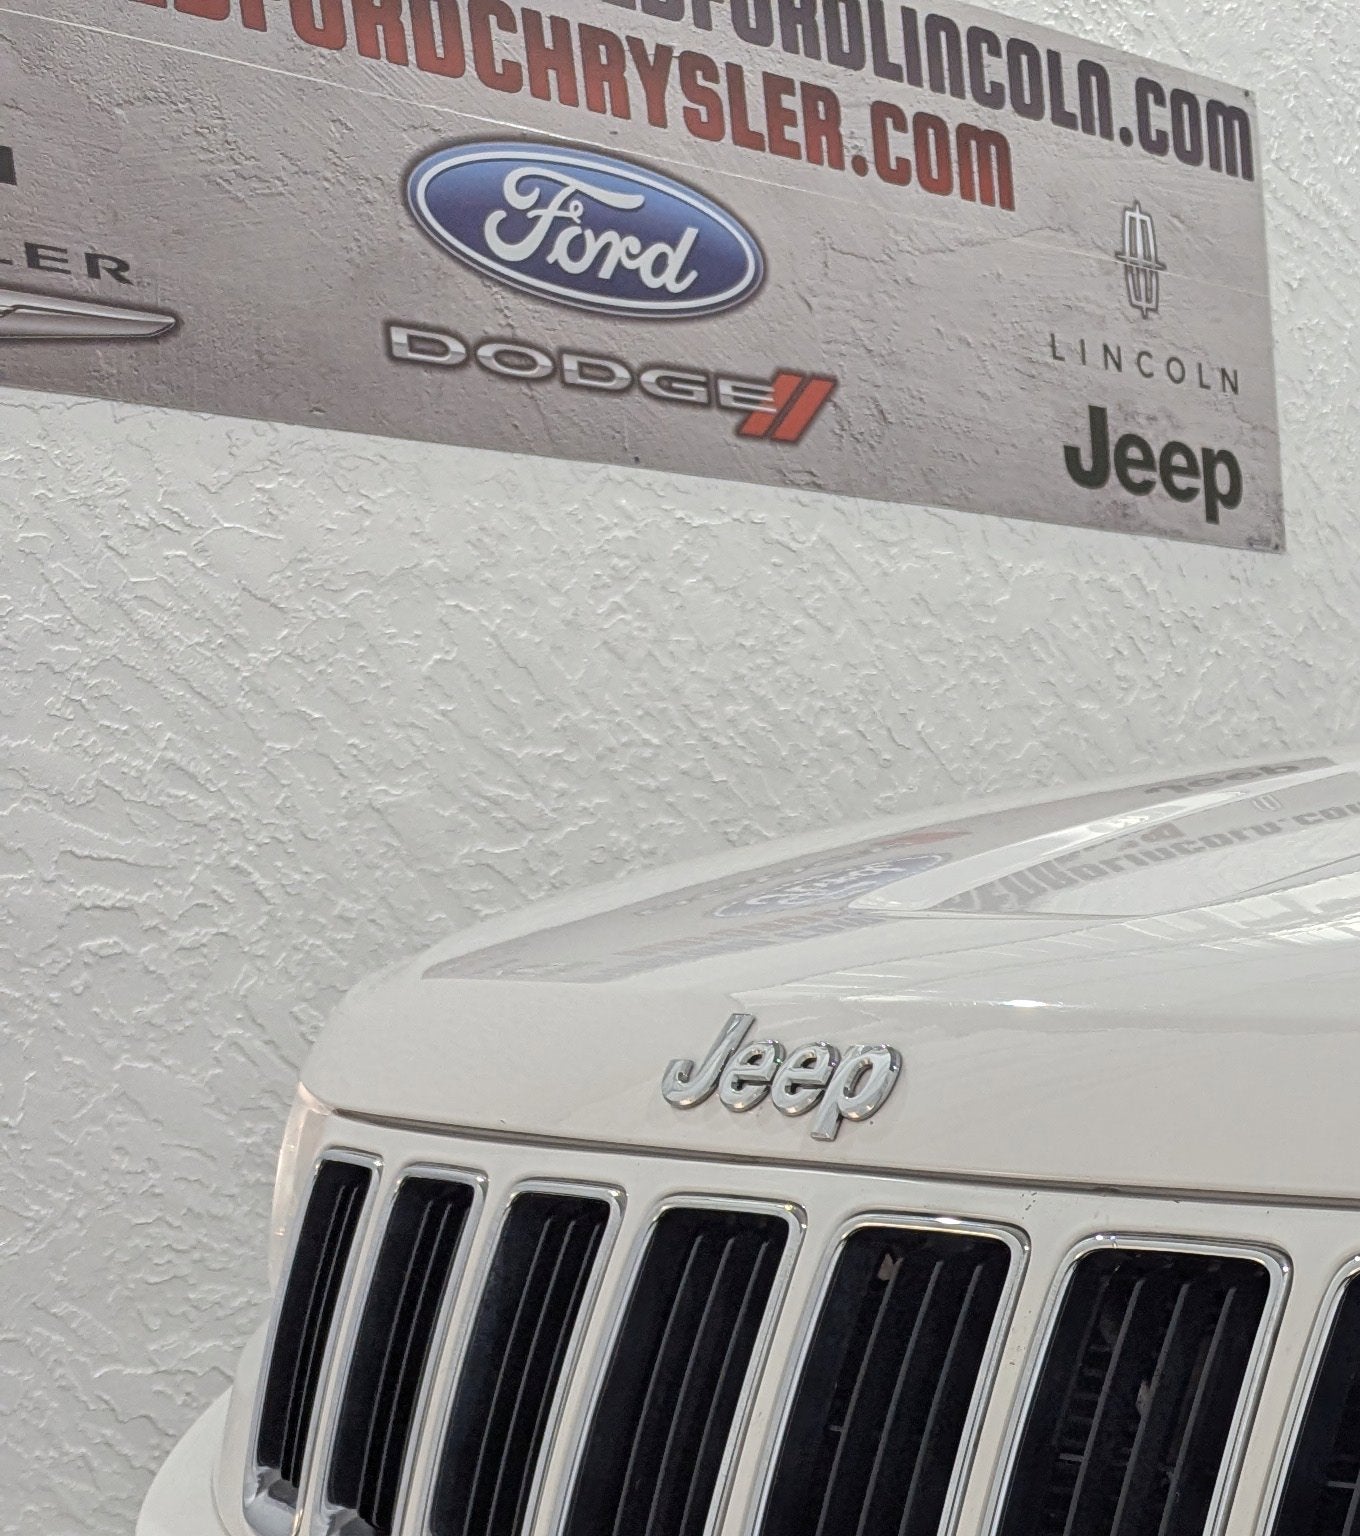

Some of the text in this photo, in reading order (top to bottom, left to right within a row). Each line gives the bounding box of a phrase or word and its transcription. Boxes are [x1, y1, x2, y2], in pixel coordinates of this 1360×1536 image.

[130, 0, 1015, 211] ORDCHRYSLER.COM
[597, 0, 1254, 182] ORDLINCOLN.COM
[0, 242, 134, 286] ER
[484, 167, 699, 294] Ford
[390, 325, 777, 414] DODGE
[1049, 333, 1240, 395] LINCOLN
[1064, 405, 1243, 524] Jeep
[661, 1012, 902, 1142] Jeep
